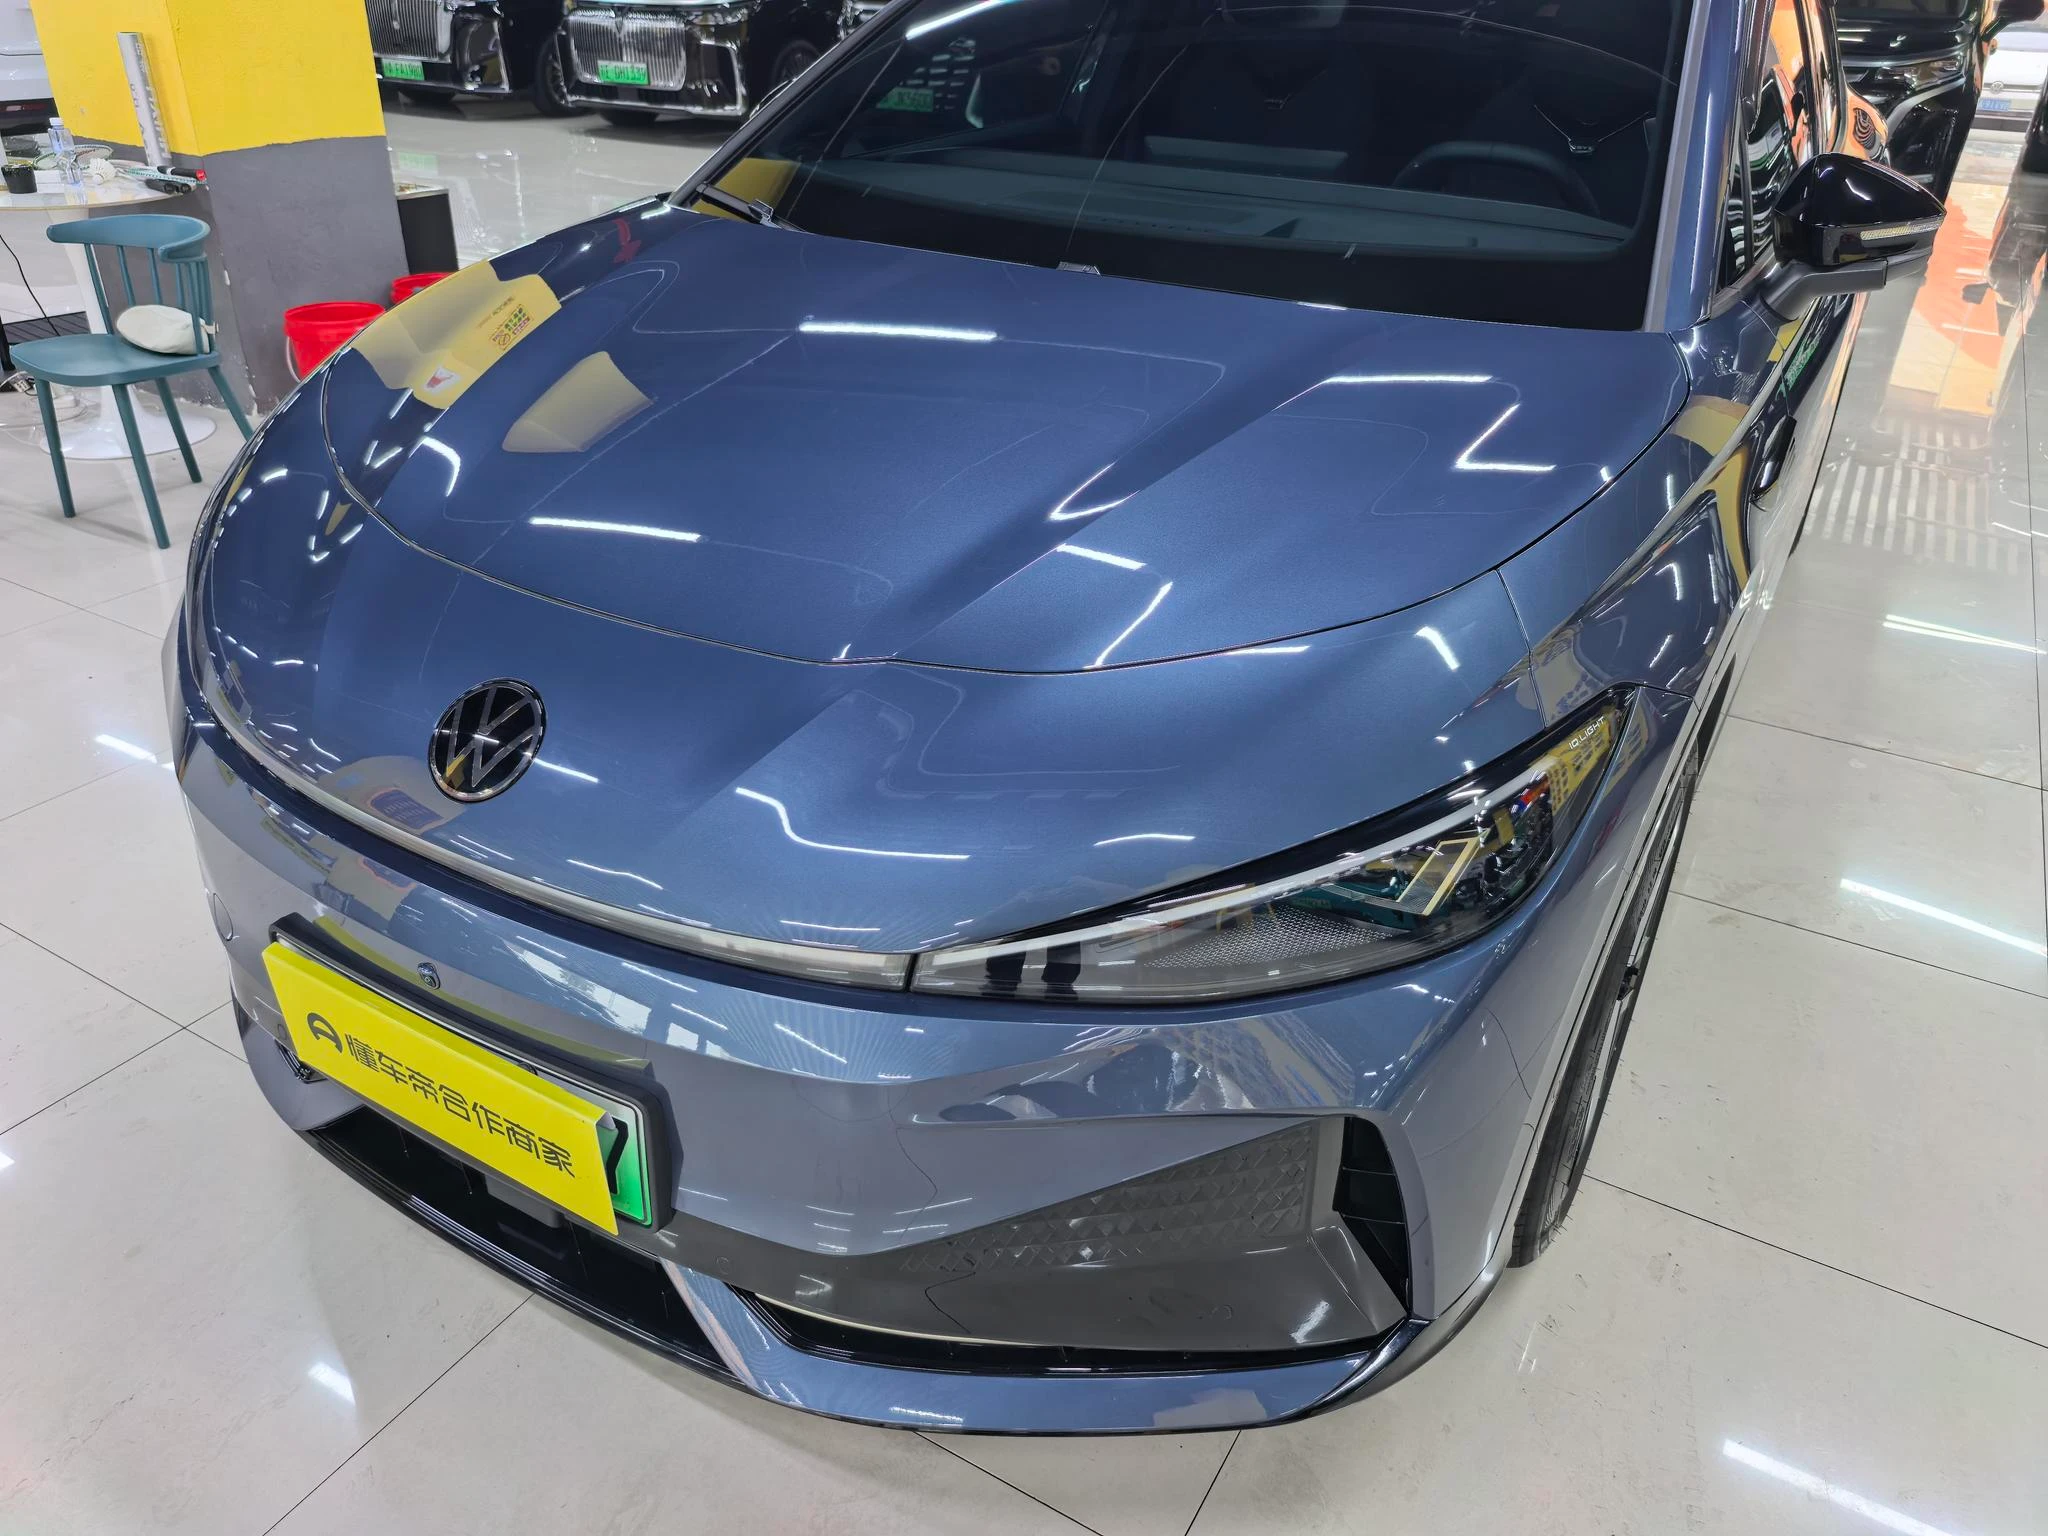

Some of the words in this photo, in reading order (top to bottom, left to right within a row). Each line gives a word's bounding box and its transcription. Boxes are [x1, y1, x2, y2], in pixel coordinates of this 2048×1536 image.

[1568, 716, 1605, 750] IQ.LIGHT
[344, 1033, 575, 1178] 懂车帝合作商家
